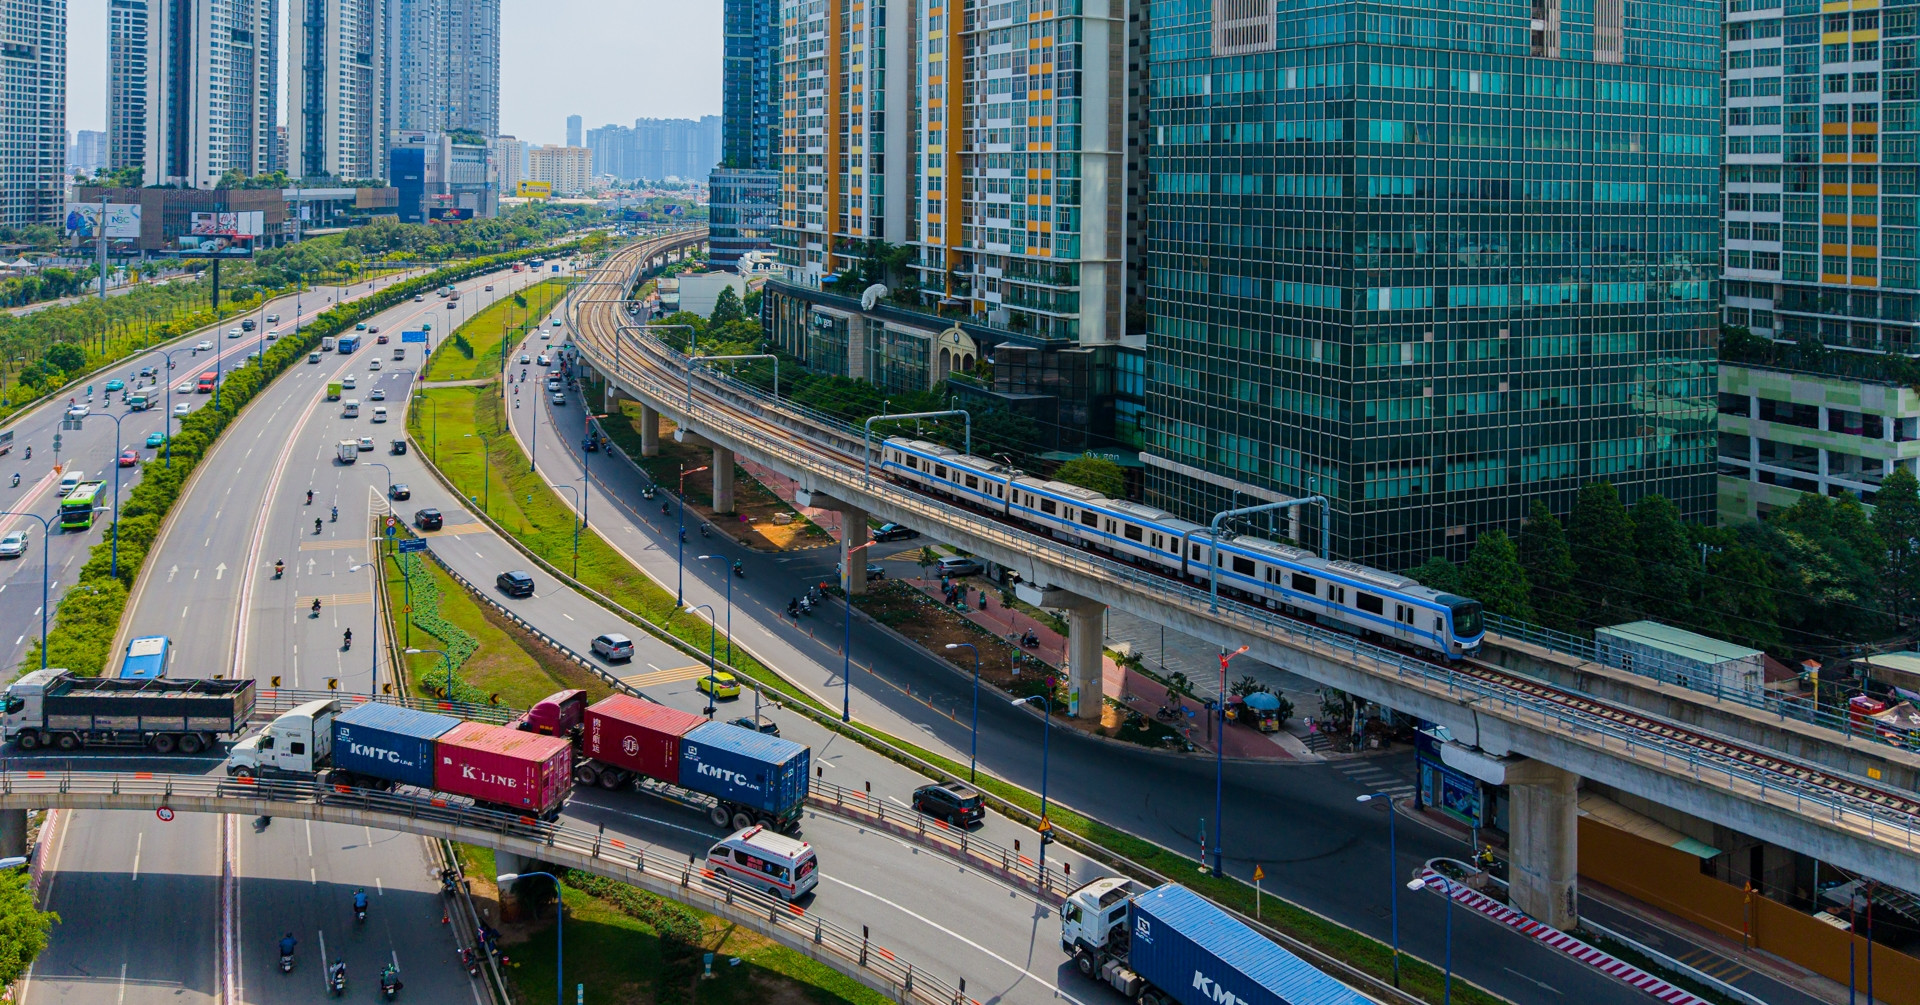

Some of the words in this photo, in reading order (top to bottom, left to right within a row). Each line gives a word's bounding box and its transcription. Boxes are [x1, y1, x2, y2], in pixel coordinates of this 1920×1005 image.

[350, 742, 400, 763] KMTC
[481, 771, 517, 788] LINE
[697, 762, 747, 786] KMTC
